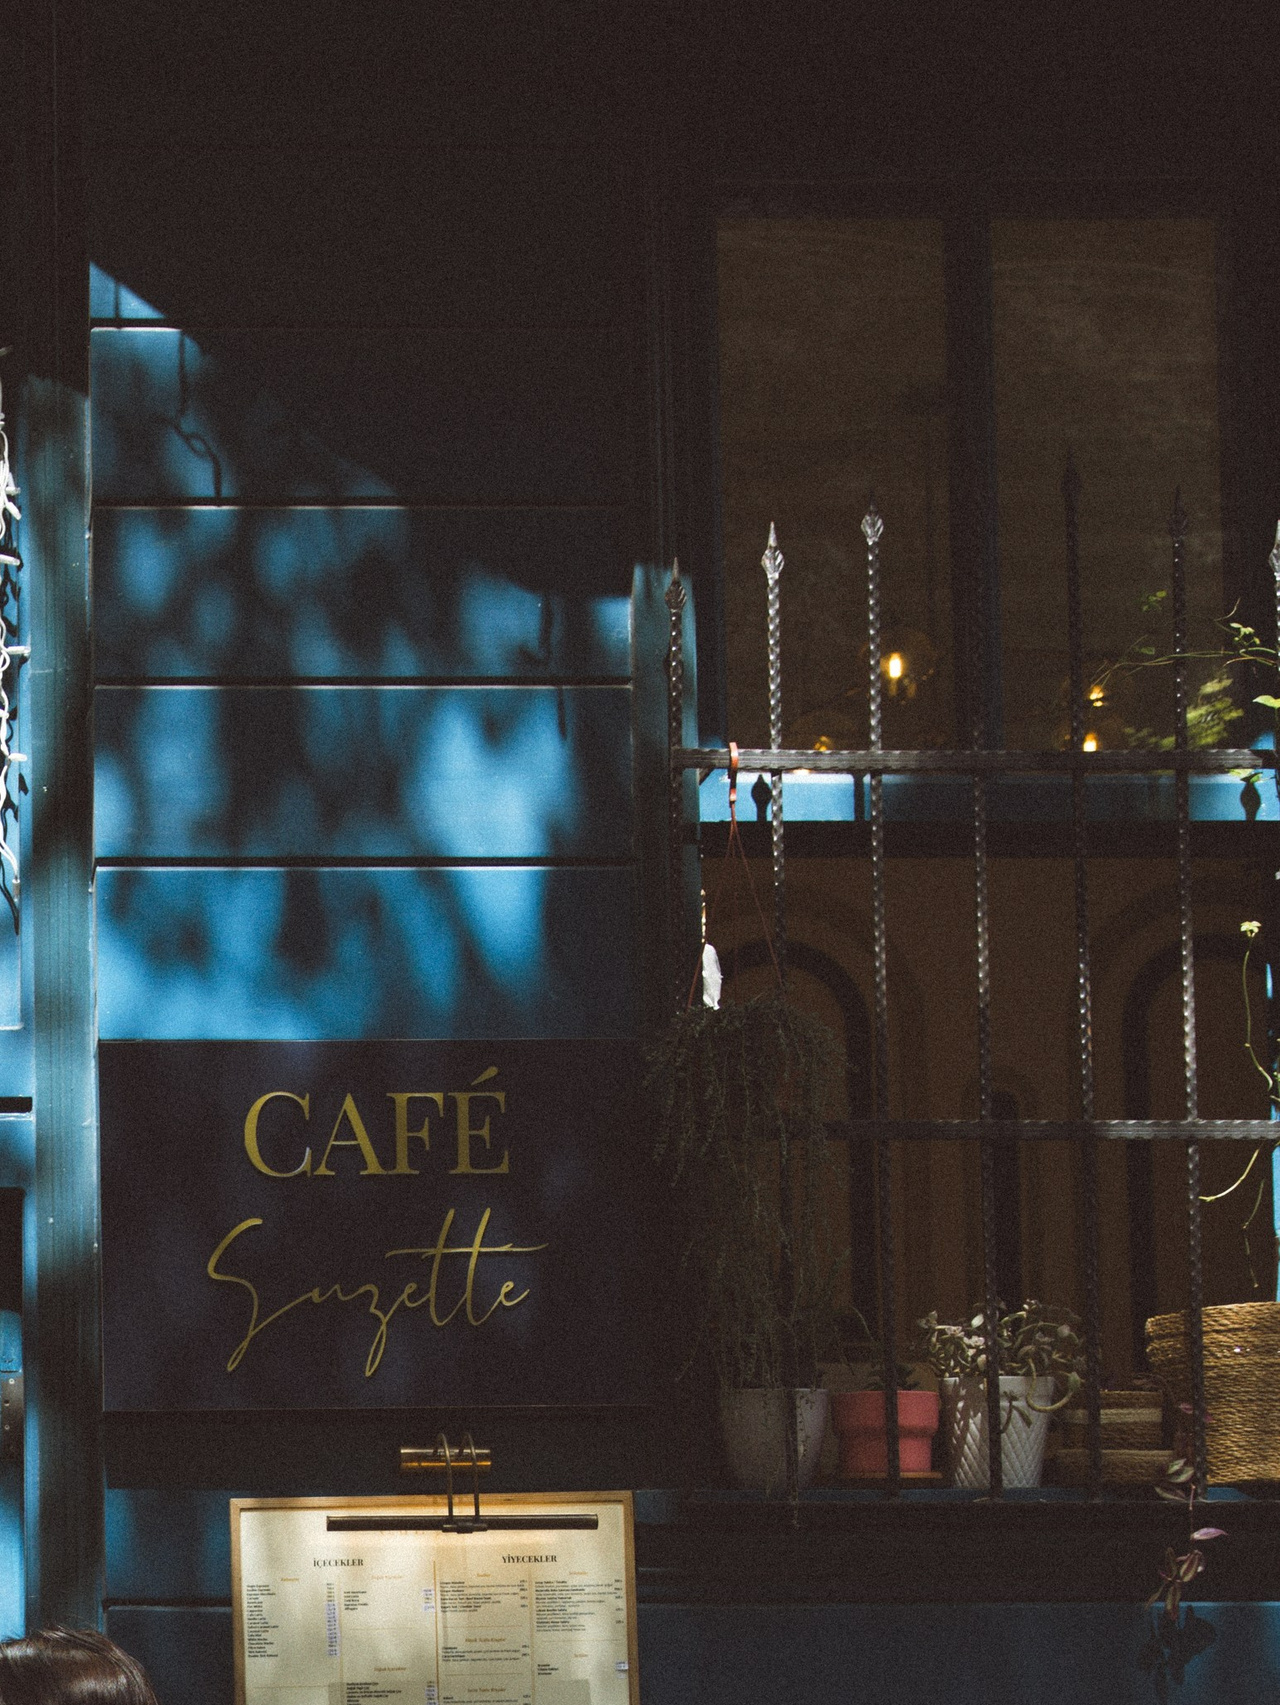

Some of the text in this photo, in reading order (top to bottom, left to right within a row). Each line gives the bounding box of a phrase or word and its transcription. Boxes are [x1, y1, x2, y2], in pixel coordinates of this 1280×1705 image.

[244, 1066, 510, 1178] CAFÉ
[207, 1207, 549, 1378] Suzette
[313, 1557, 364, 1568] İÇECEKLER
[502, 1553, 558, 1565] YİYECEKLER
